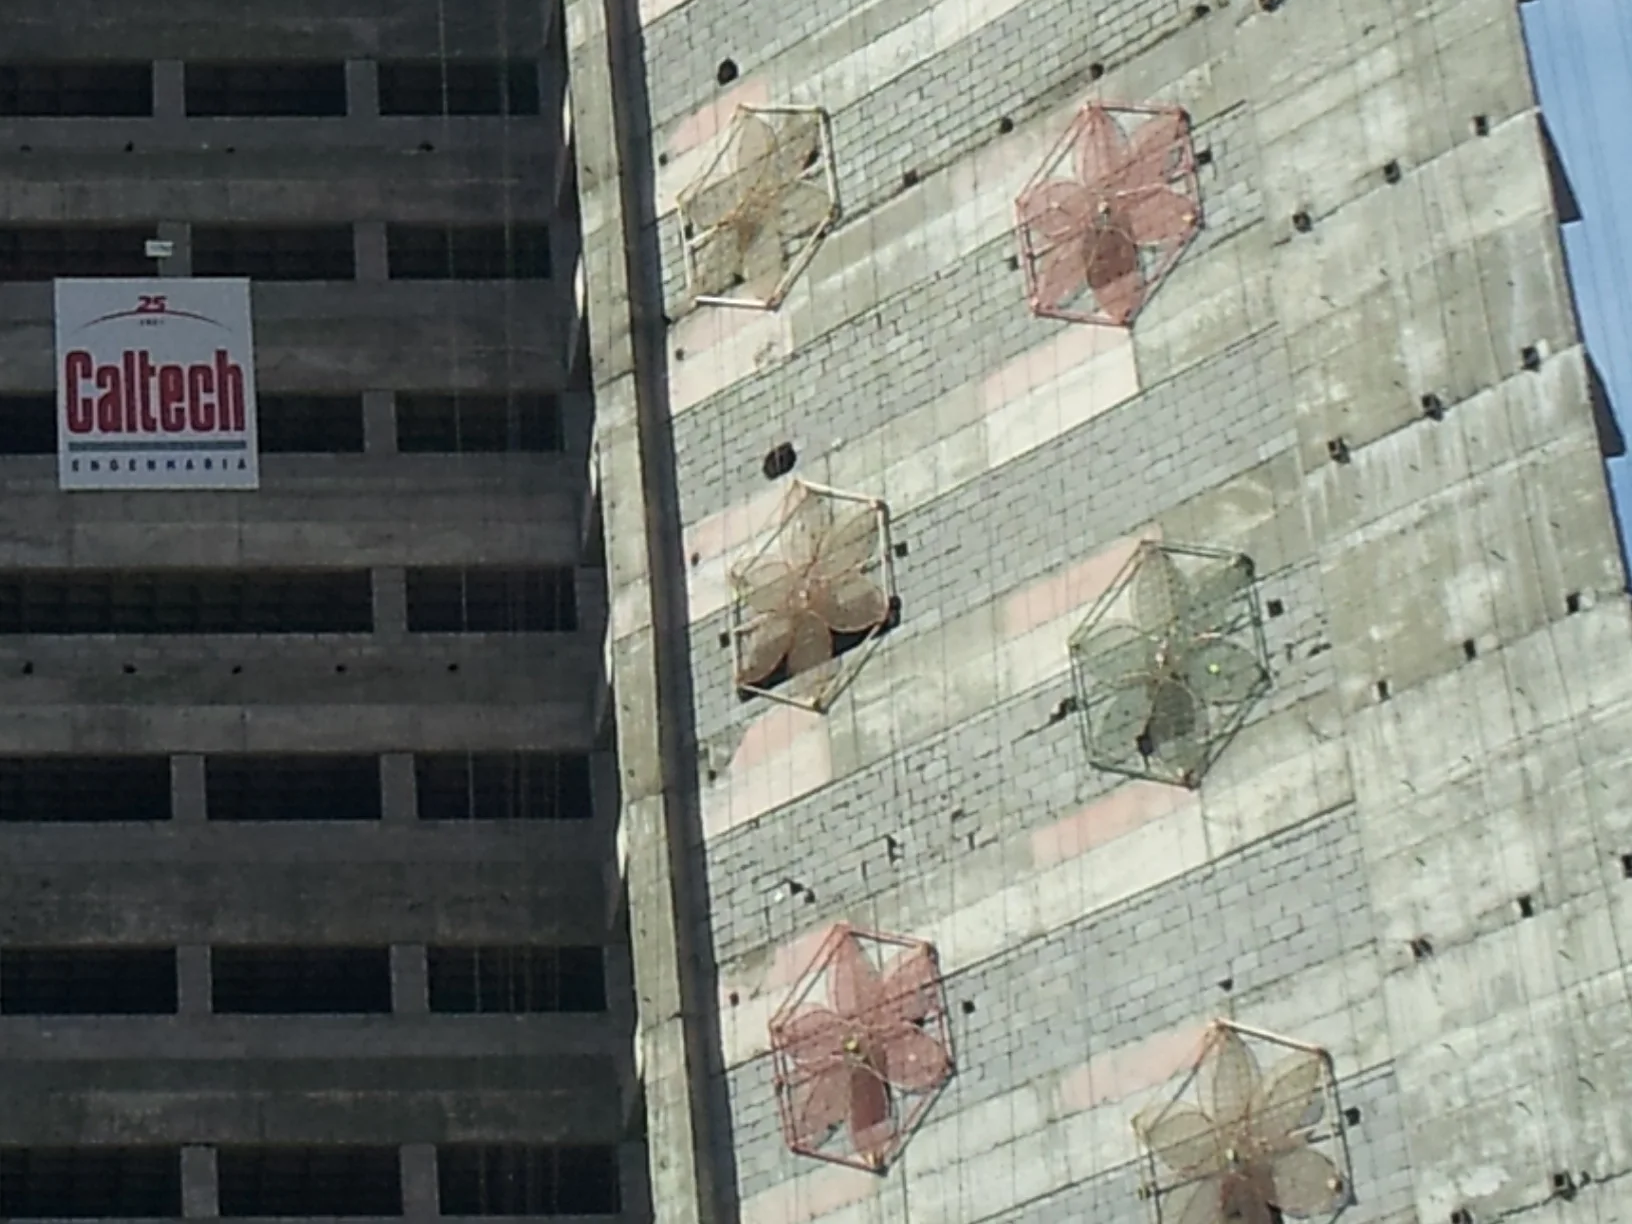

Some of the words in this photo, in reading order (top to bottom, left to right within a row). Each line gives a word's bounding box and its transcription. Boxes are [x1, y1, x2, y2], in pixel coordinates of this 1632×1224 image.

[136, 295, 166, 313] 25
[66, 350, 245, 432] Caltech
[71, 458, 246, 471] ENGENHARIA
